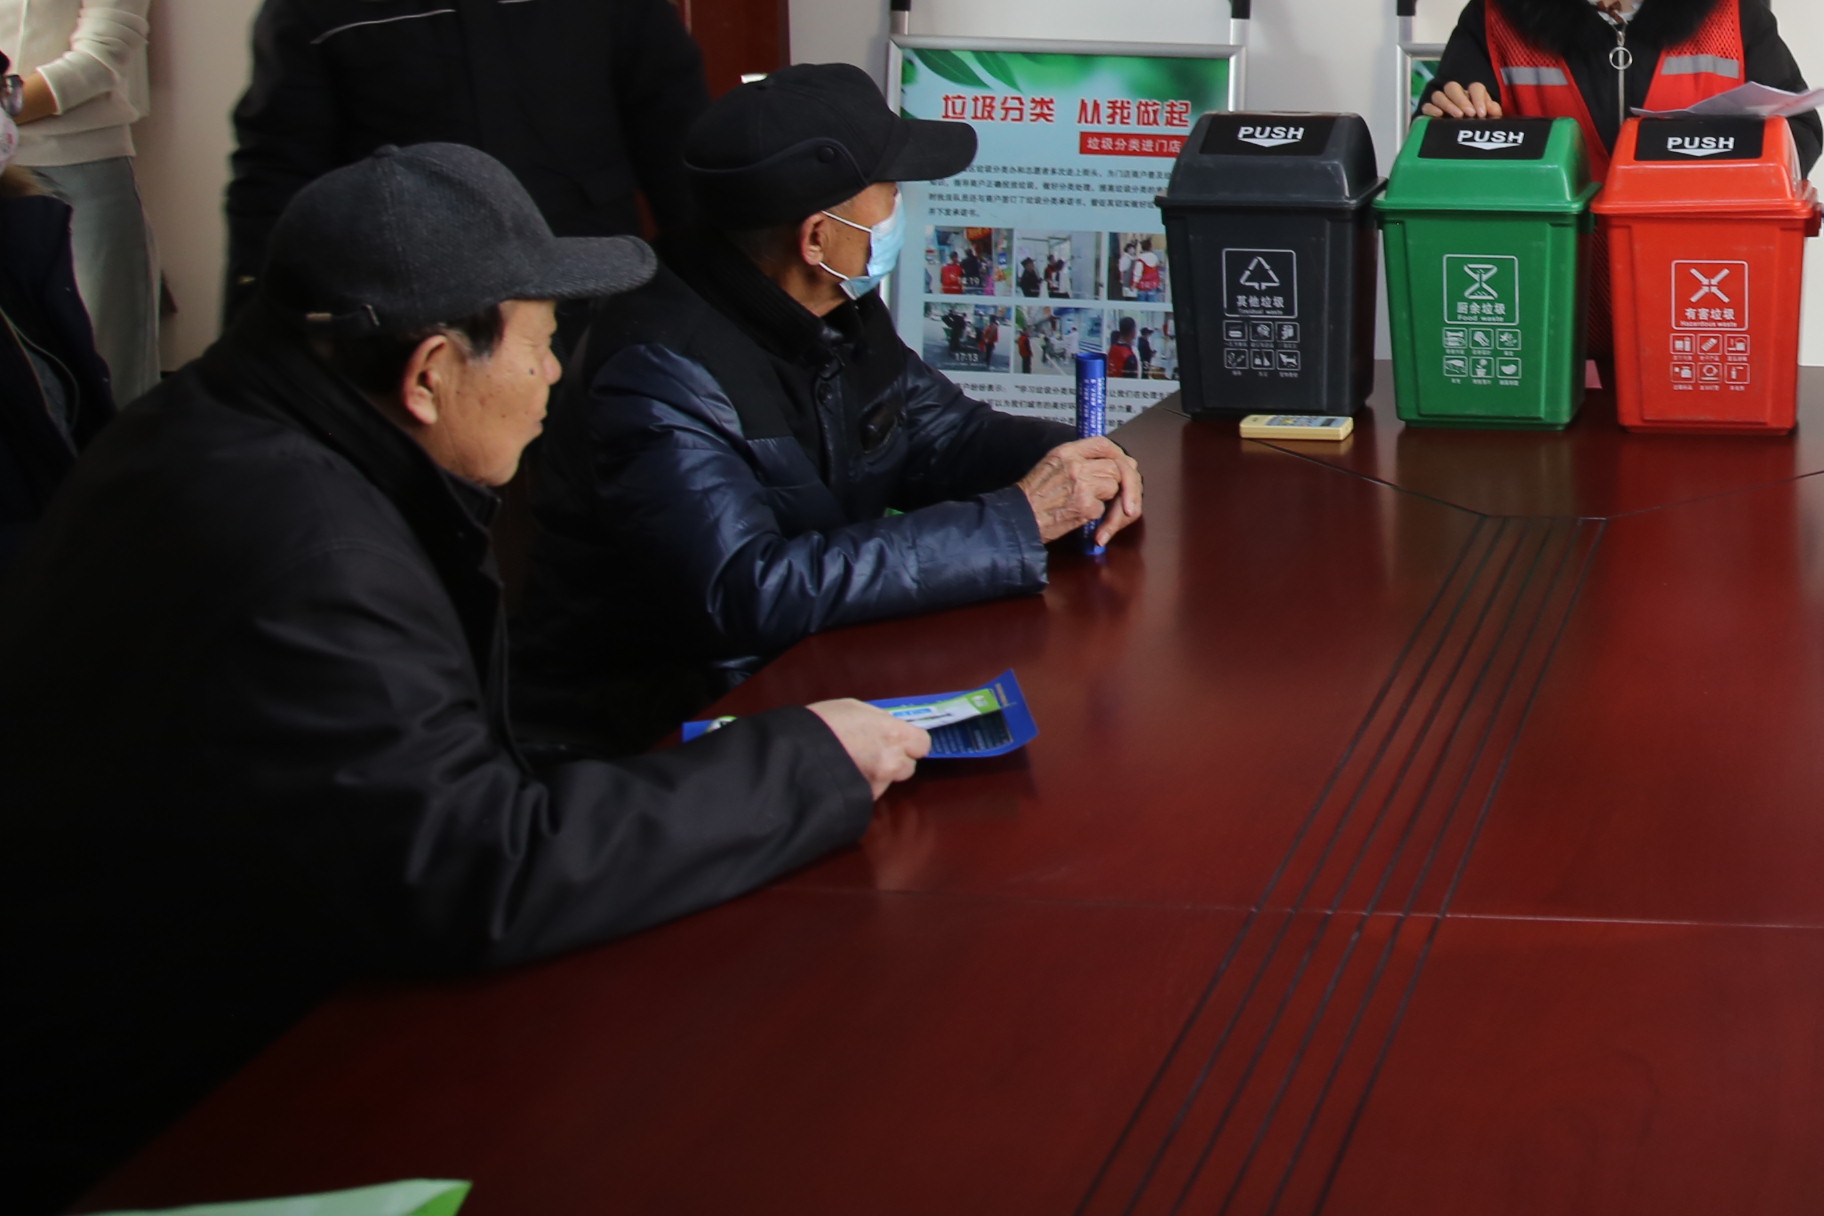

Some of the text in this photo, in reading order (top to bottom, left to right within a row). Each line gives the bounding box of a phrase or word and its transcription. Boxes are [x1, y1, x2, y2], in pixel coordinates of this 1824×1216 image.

[941, 93, 1192, 129] 垃圾分类 从我做起
[1237, 125, 1305, 141] PUSH
[1456, 129, 1525, 145] PUSH
[1667, 136, 1735, 151] PUSH
[1236, 295, 1285, 309] 其他垃圾
[1456, 301, 1506, 315] 厨余垃圾
[1685, 307, 1736, 321] 有害垃圾
